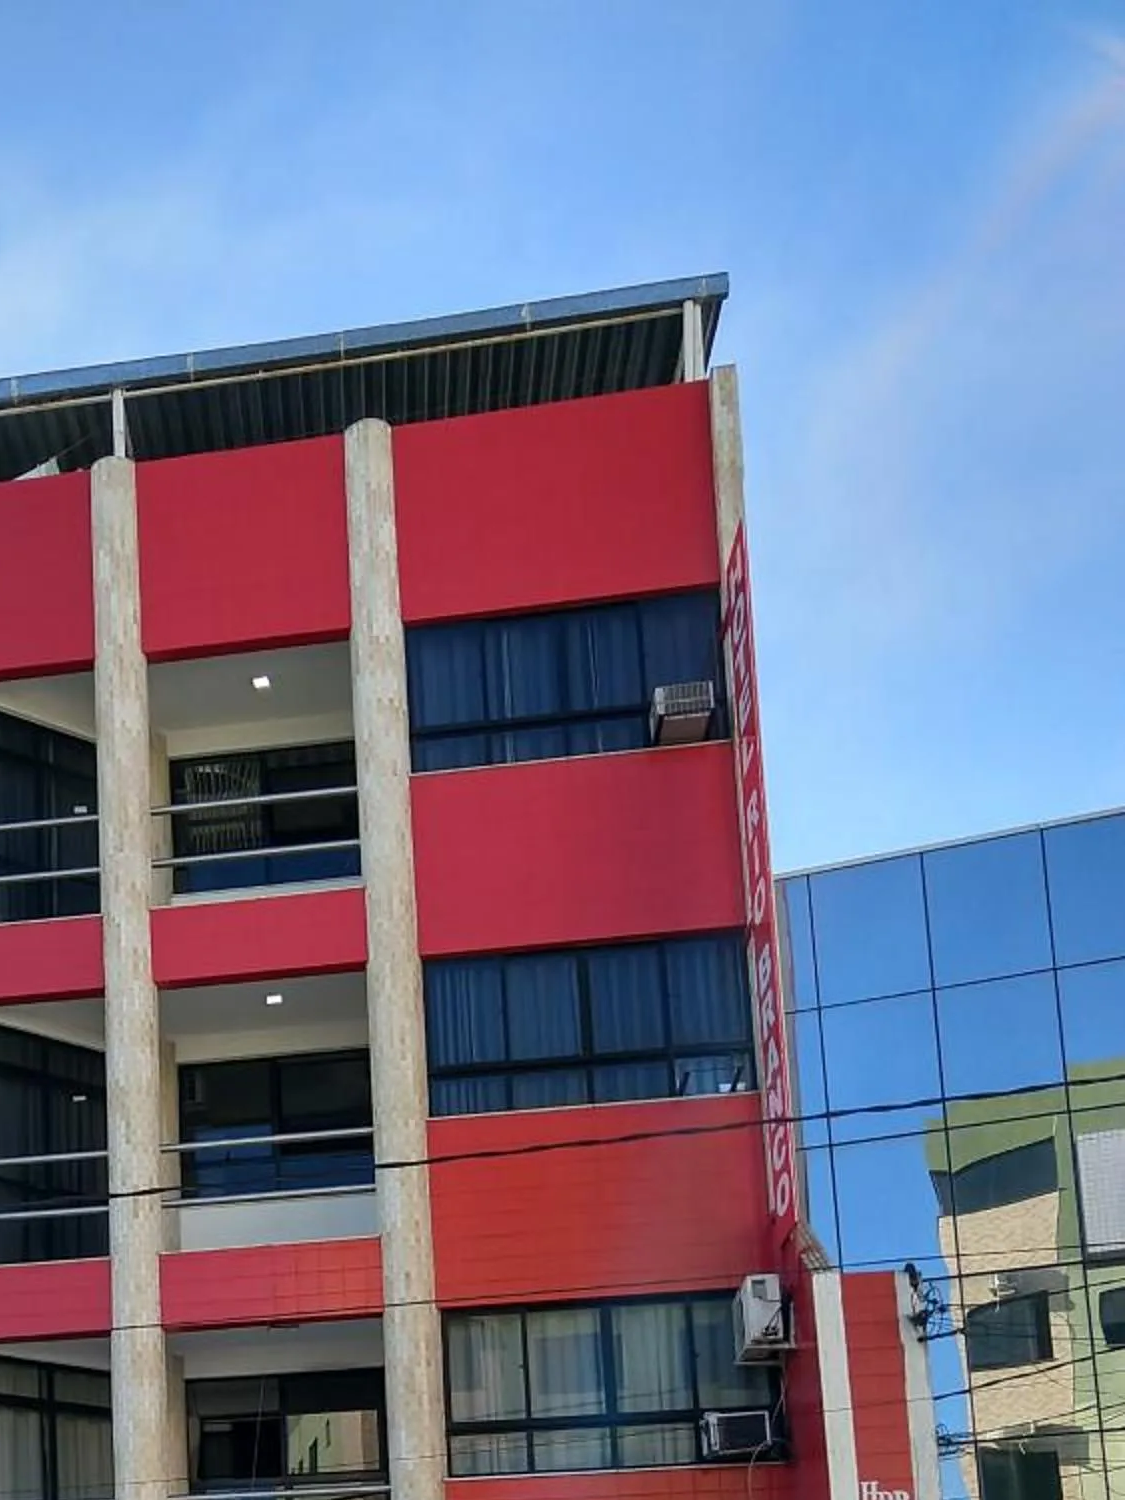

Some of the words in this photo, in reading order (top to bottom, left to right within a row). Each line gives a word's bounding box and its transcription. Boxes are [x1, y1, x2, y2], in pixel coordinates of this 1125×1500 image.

[728, 541, 755, 779] HOTEL
[746, 789, 766, 925] RIO
[758, 944, 790, 1217] BRANCO
